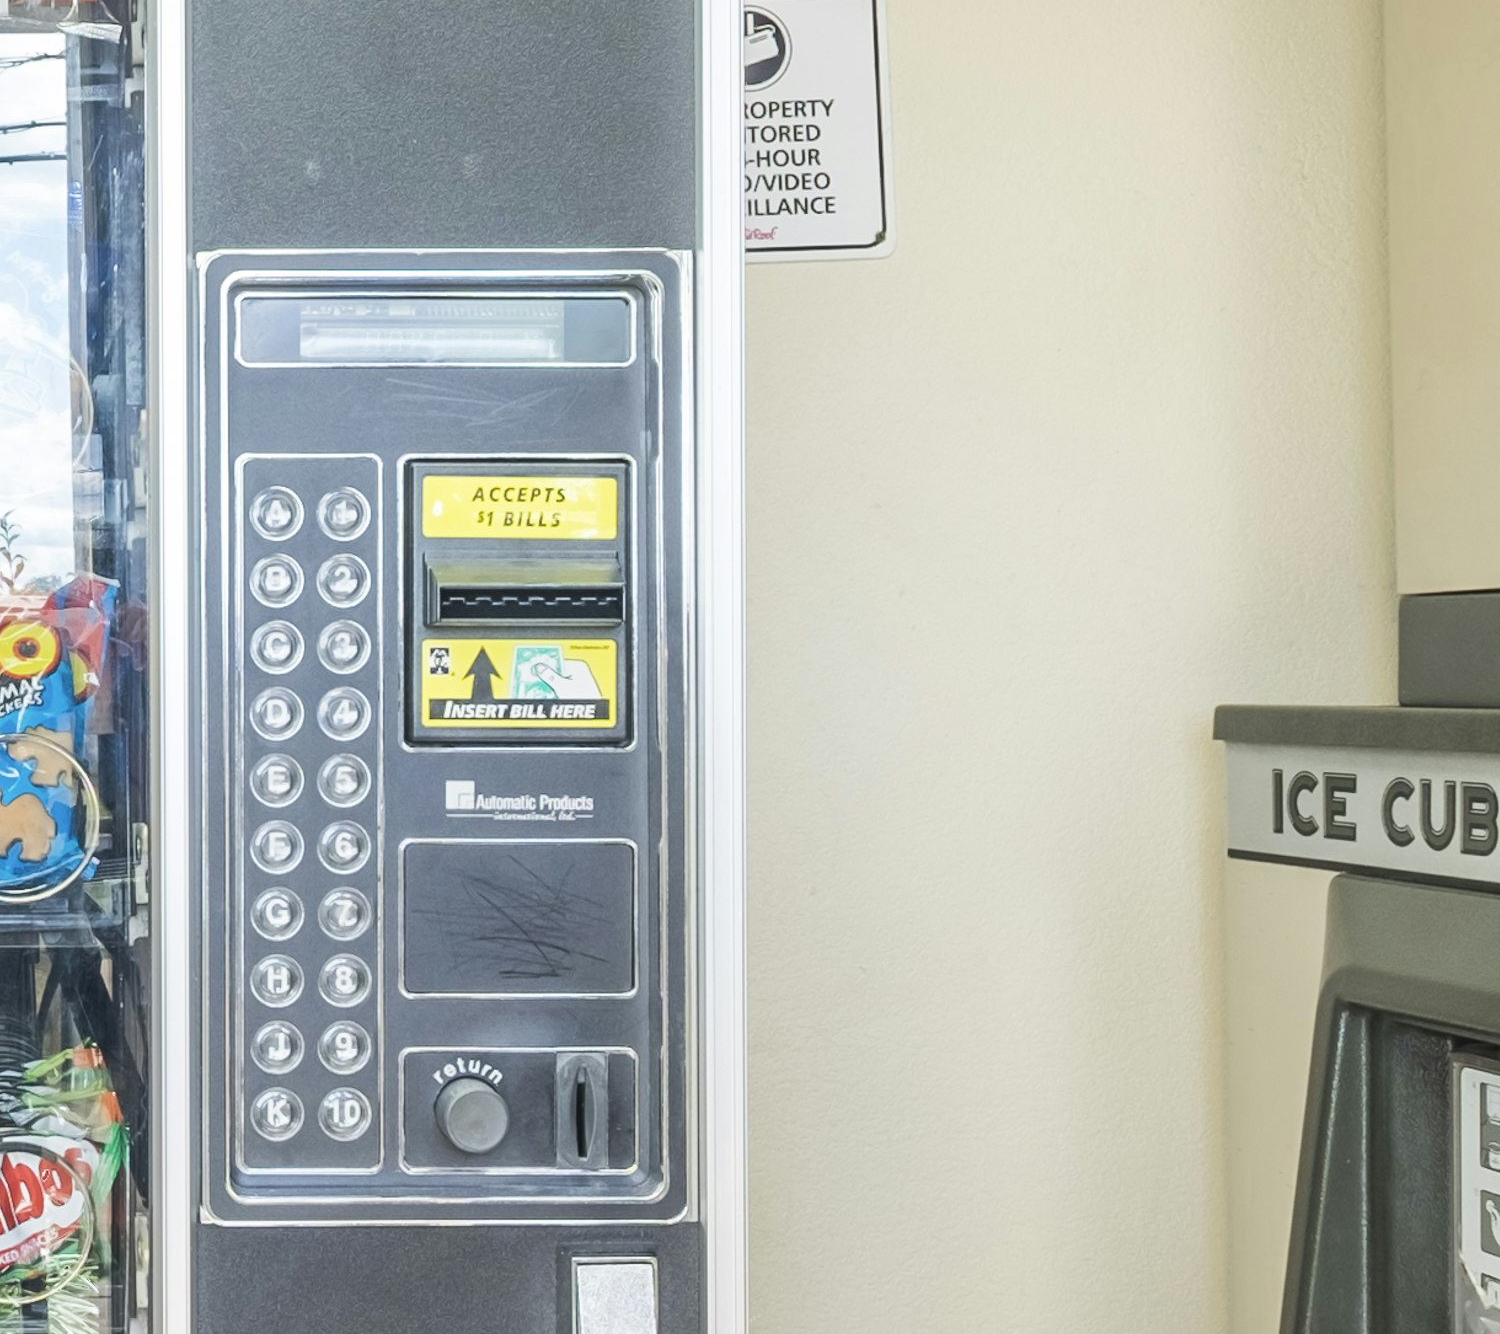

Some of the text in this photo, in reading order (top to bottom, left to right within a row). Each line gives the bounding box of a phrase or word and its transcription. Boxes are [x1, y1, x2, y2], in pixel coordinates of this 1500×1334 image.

[745, 99, 835, 121] OPERTY
[747, 124, 821, 144] TORED
[745, 148, 821, 168] -HOUR
[745, 172, 831, 193] /VIDEO
[746, 196, 837, 217] ILLANCE
[472, 487, 567, 504] ACCEPTS
[265, 499, 292, 527] A
[477, 510, 561, 528] $1 BILLS
[265, 565, 292, 592] B
[329, 565, 358, 594] 2
[264, 631, 292, 661] C
[332, 631, 358, 660] 3
[264, 698, 291, 728] D
[332, 698, 358, 726] 4
[443, 700, 597, 719] INSERT BILL HERE
[266, 765, 292, 794] E
[334, 765, 358, 794] 5
[475, 793, 595, 811] Automatic Products
[1271, 768, 1358, 843] ICE
[268, 831, 292, 861] F
[334, 831, 359, 859] 6
[265, 898, 292, 927] G
[266, 965, 292, 994] H
[334, 965, 358, 994] 8
[268, 1032, 292, 1061] J
[334, 1032, 358, 1061] 9
[433, 1056, 504, 1087] return
[266, 1098, 291, 1126] K
[327, 1099, 360, 1128] 10
